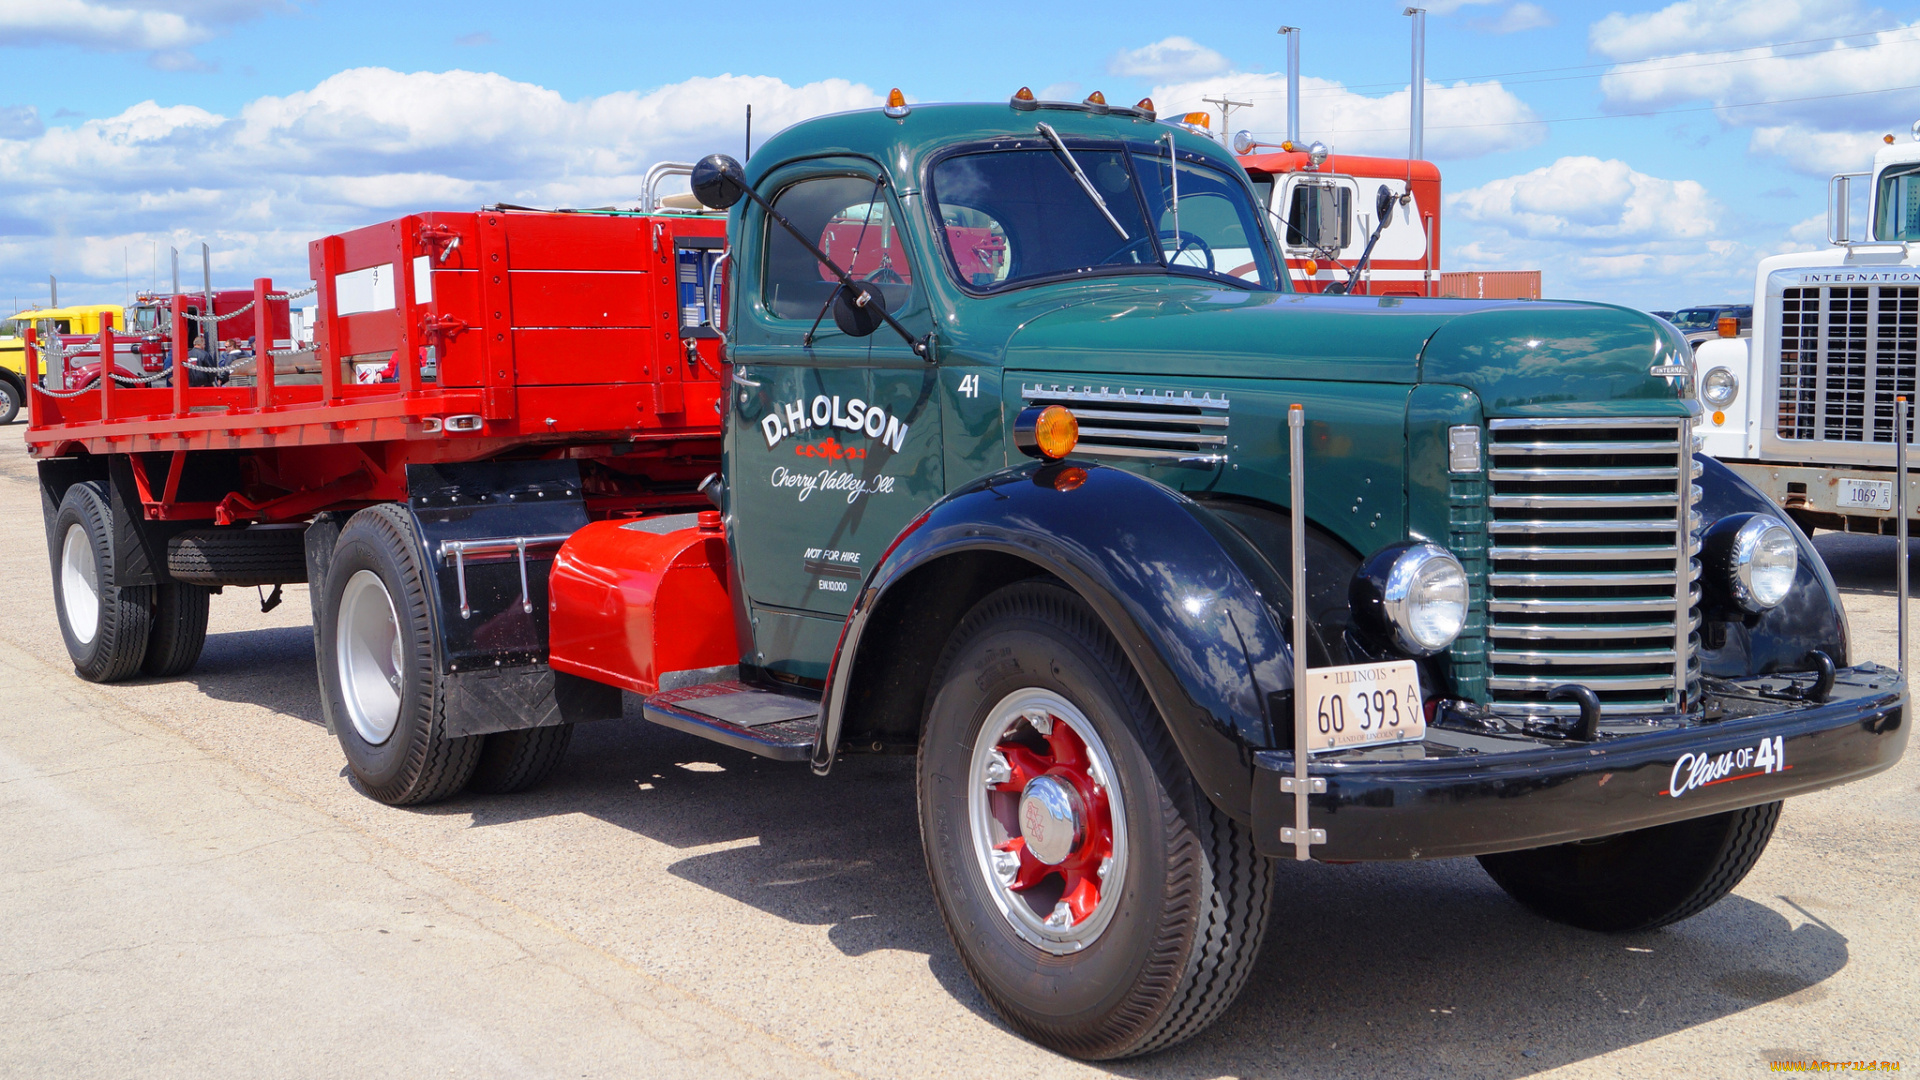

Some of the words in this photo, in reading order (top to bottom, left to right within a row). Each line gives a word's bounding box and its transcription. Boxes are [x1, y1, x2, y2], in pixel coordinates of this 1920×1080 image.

[958, 374, 979, 398] 41
[1021, 382, 1230, 406] INTERNATIONAL
[771, 466, 817, 502] Cherry
[1851, 488, 1877, 502] 1069
[803, 547, 823, 559] NOT
[822, 549, 840, 561] FOR
[840, 551, 861, 563] HIRE
[1335, 668, 1387, 685] ILLINOIS
[1318, 694, 1344, 734] 60
[1357, 688, 1400, 730] 393
[1338, 735, 1356, 744] LAND
[1356, 734, 1365, 742] OF
[1366, 730, 1394, 740] LINCOLN
[1669, 751, 1735, 798] Class
[1736, 747, 1754, 769] OF
[1753, 735, 1784, 774] 41
